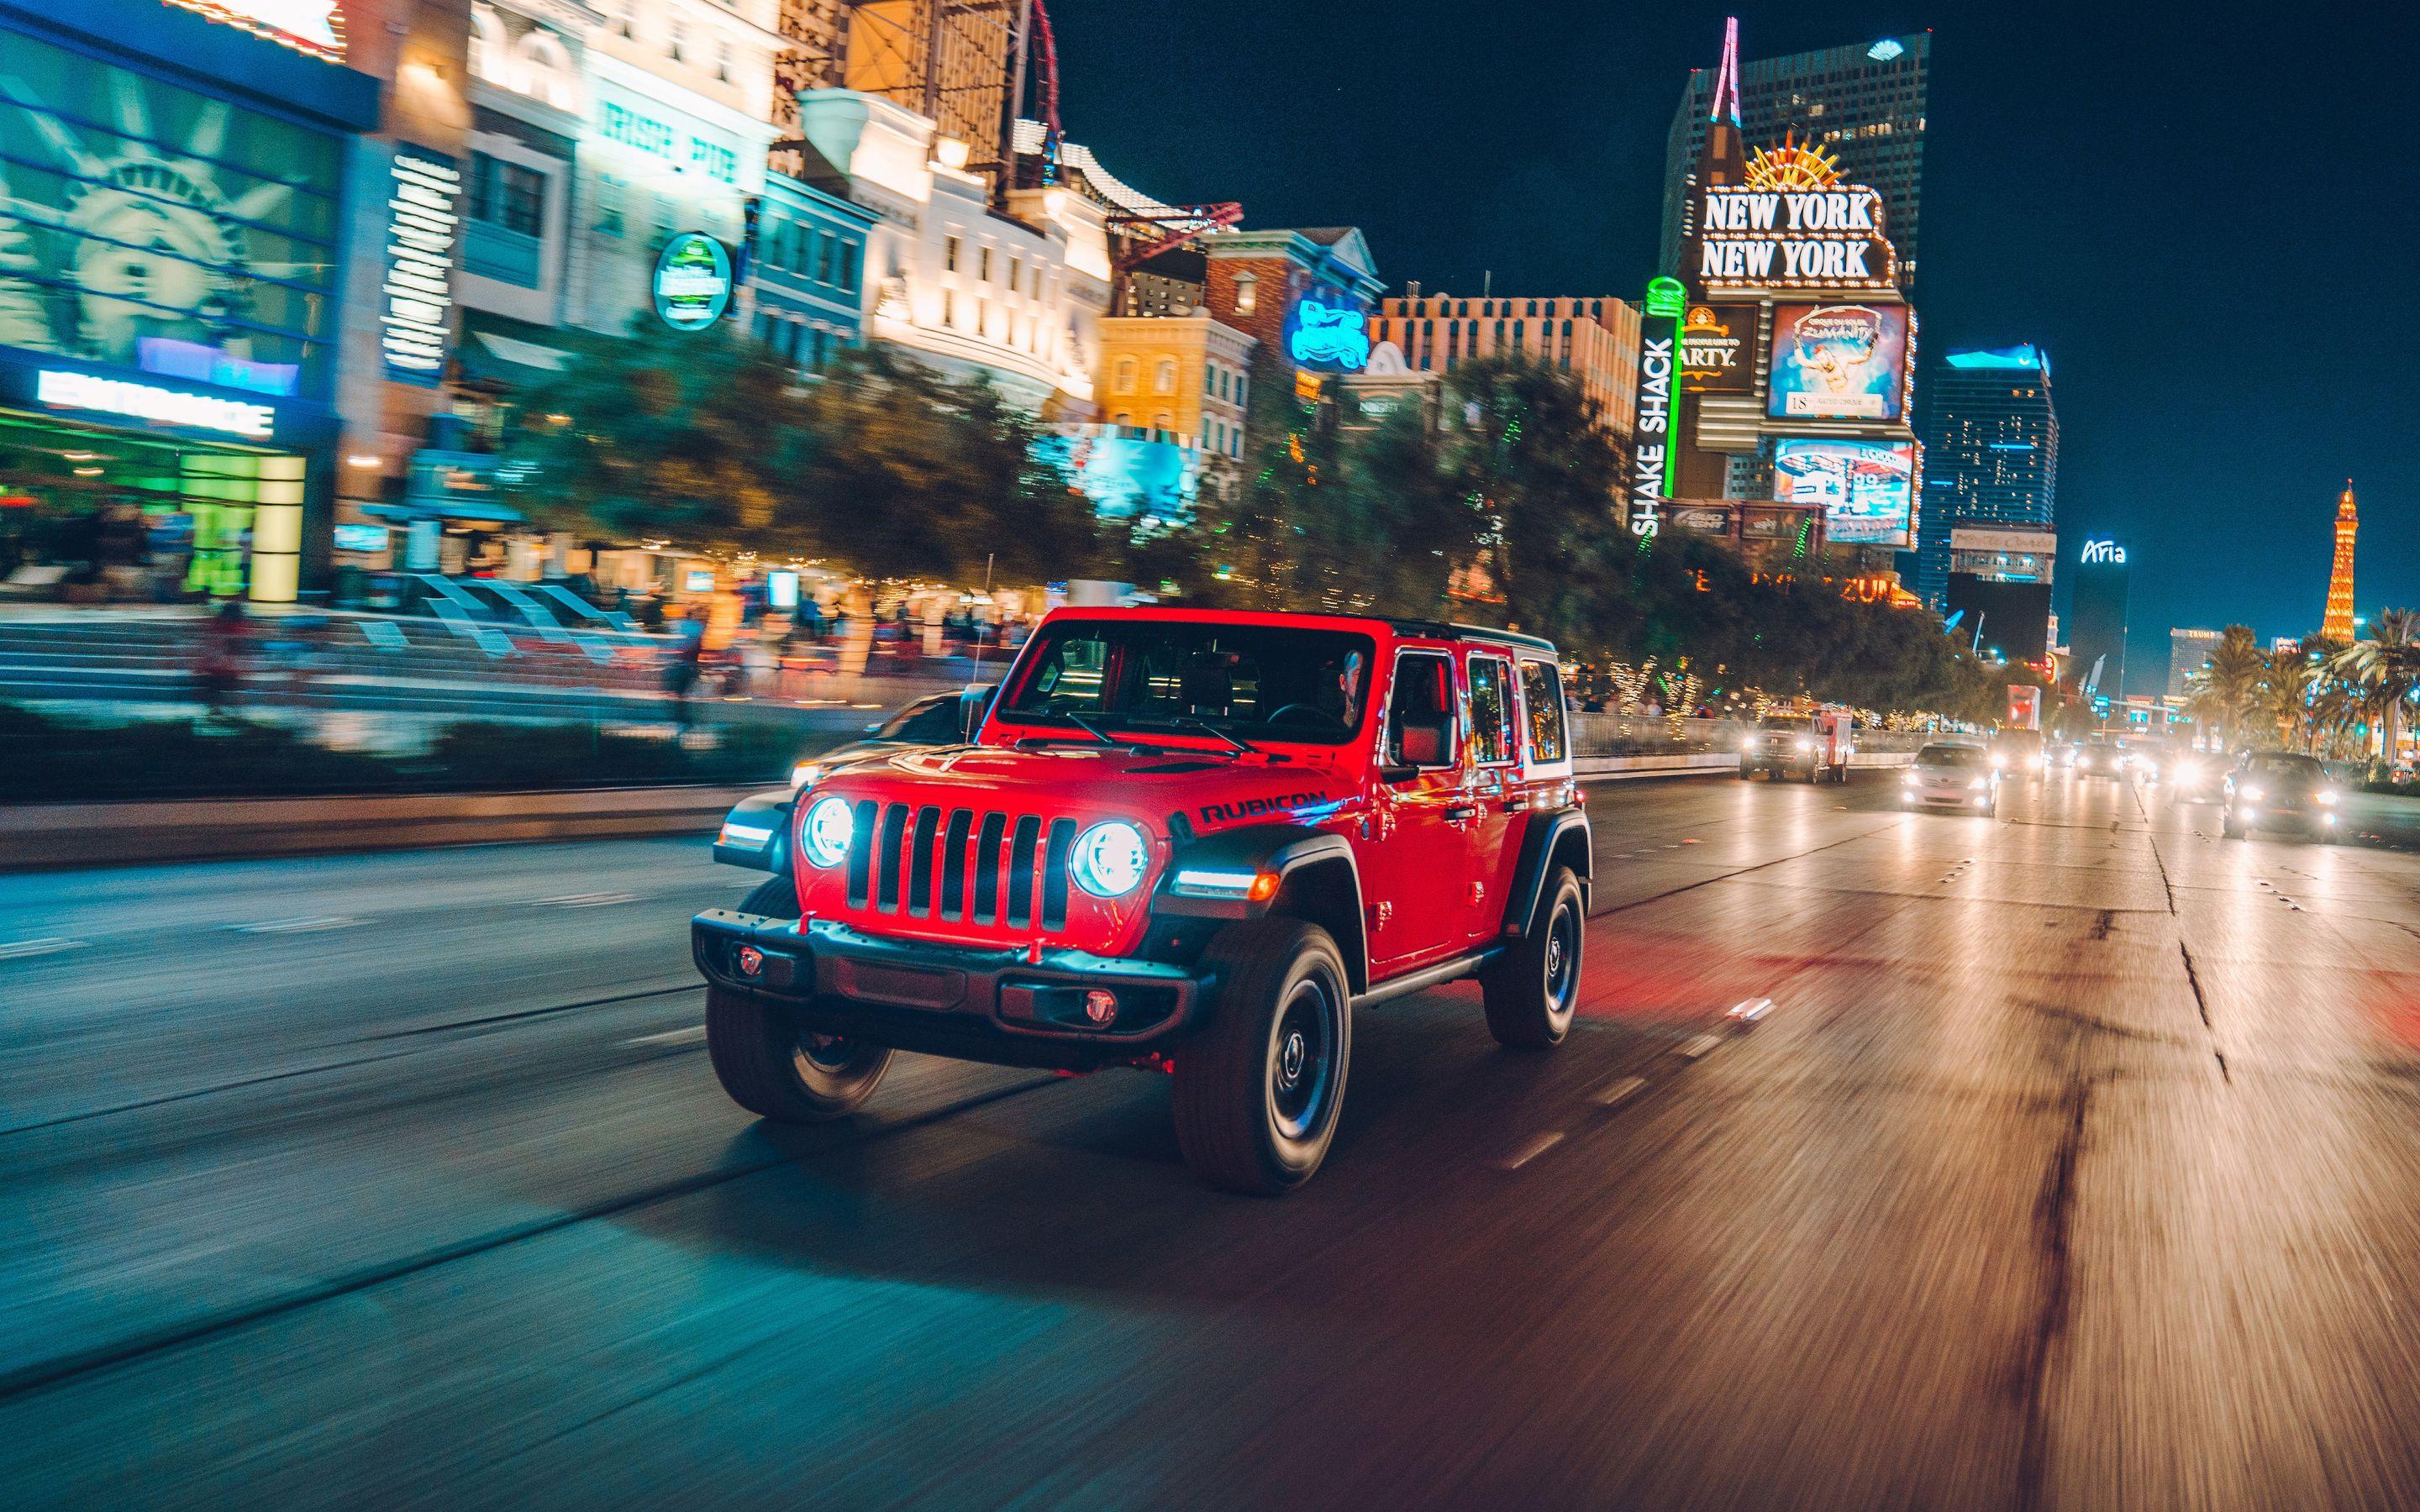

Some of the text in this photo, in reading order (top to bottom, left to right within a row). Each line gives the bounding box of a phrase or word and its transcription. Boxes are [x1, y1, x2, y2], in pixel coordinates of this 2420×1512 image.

[1703, 192, 1873, 230] NEW YORK
[1700, 240, 1870, 278] NEW YORK
[1802, 325, 1874, 344] ZUMANITY
[1680, 348, 1736, 366] ARTY.
[1631, 337, 1673, 537] SHAKE SHACK
[2081, 540, 2126, 564] Aria
[2188, 630, 2216, 638] TRUMP
[1199, 791, 1328, 823] RUBICON
